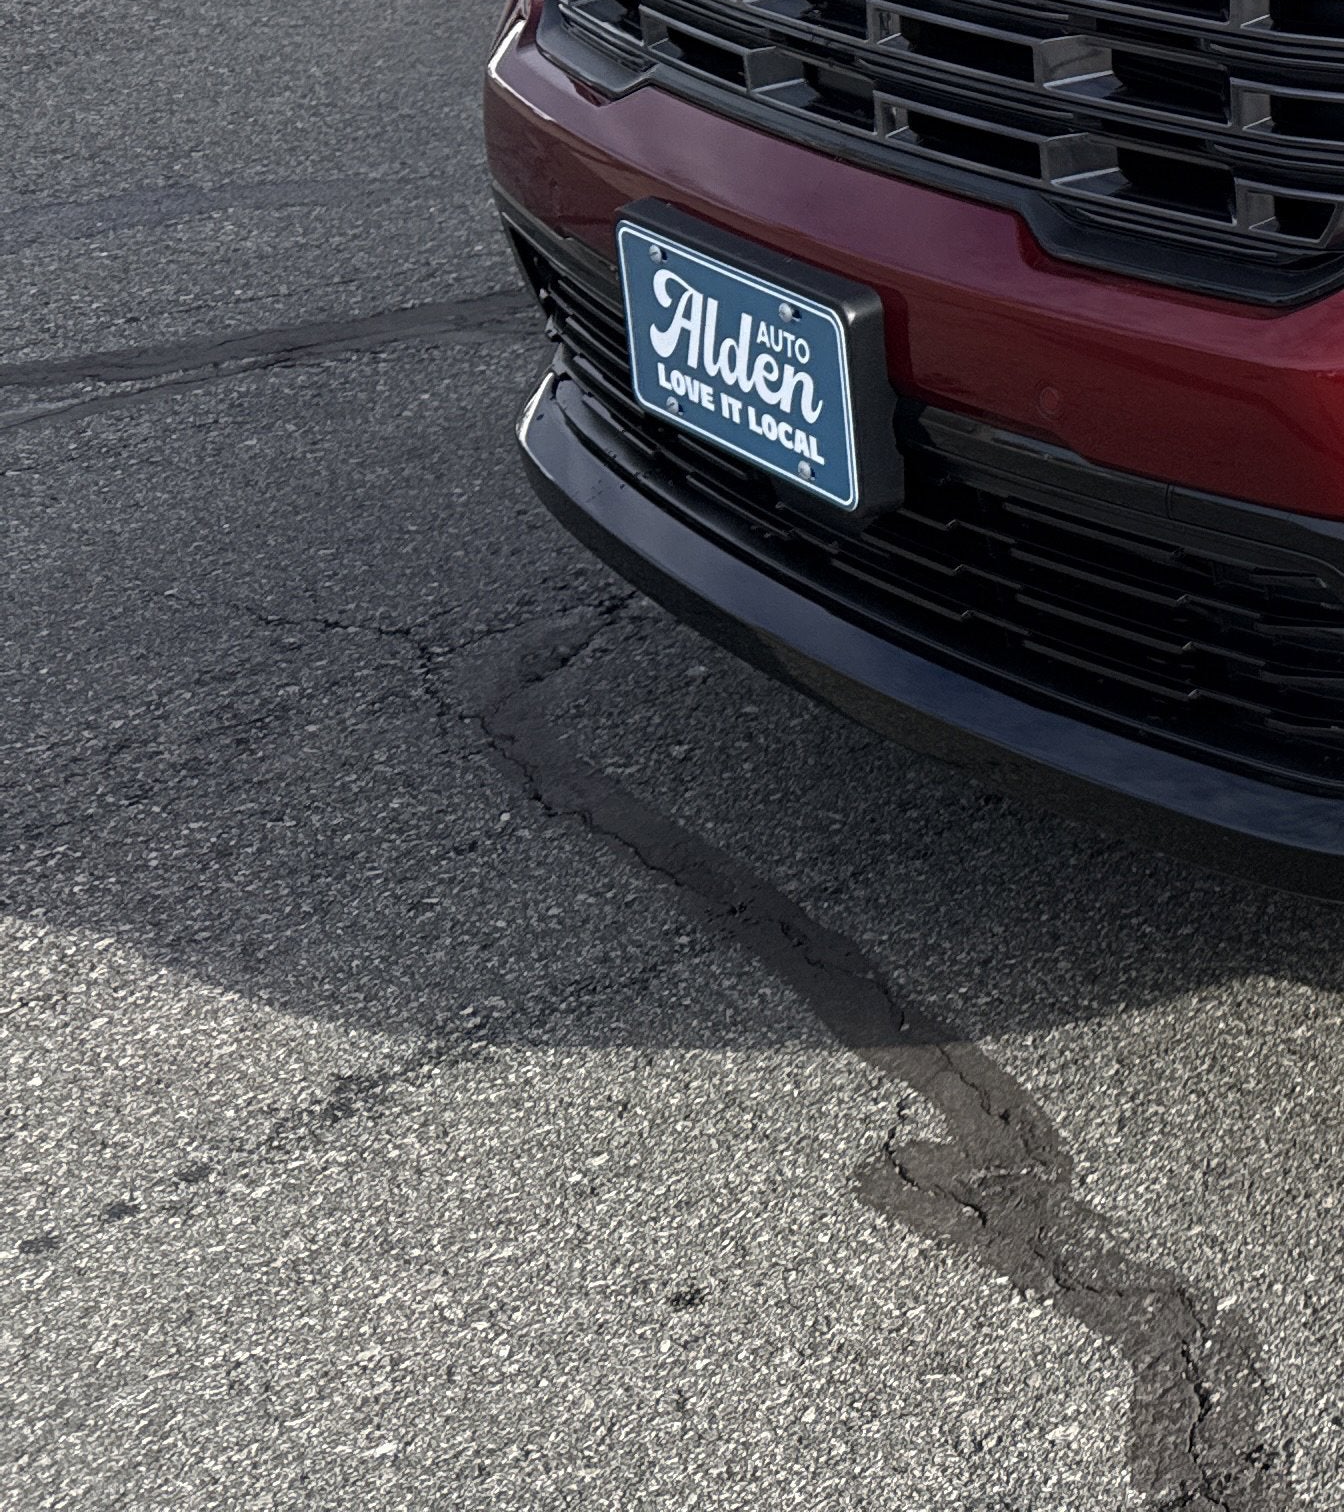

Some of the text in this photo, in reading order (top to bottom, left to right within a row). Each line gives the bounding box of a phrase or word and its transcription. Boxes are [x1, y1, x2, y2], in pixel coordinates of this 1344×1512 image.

[650, 268, 823, 424] Alden
[757, 321, 810, 364] AUTO
[657, 362, 825, 466] LOVE IT LOCAL
